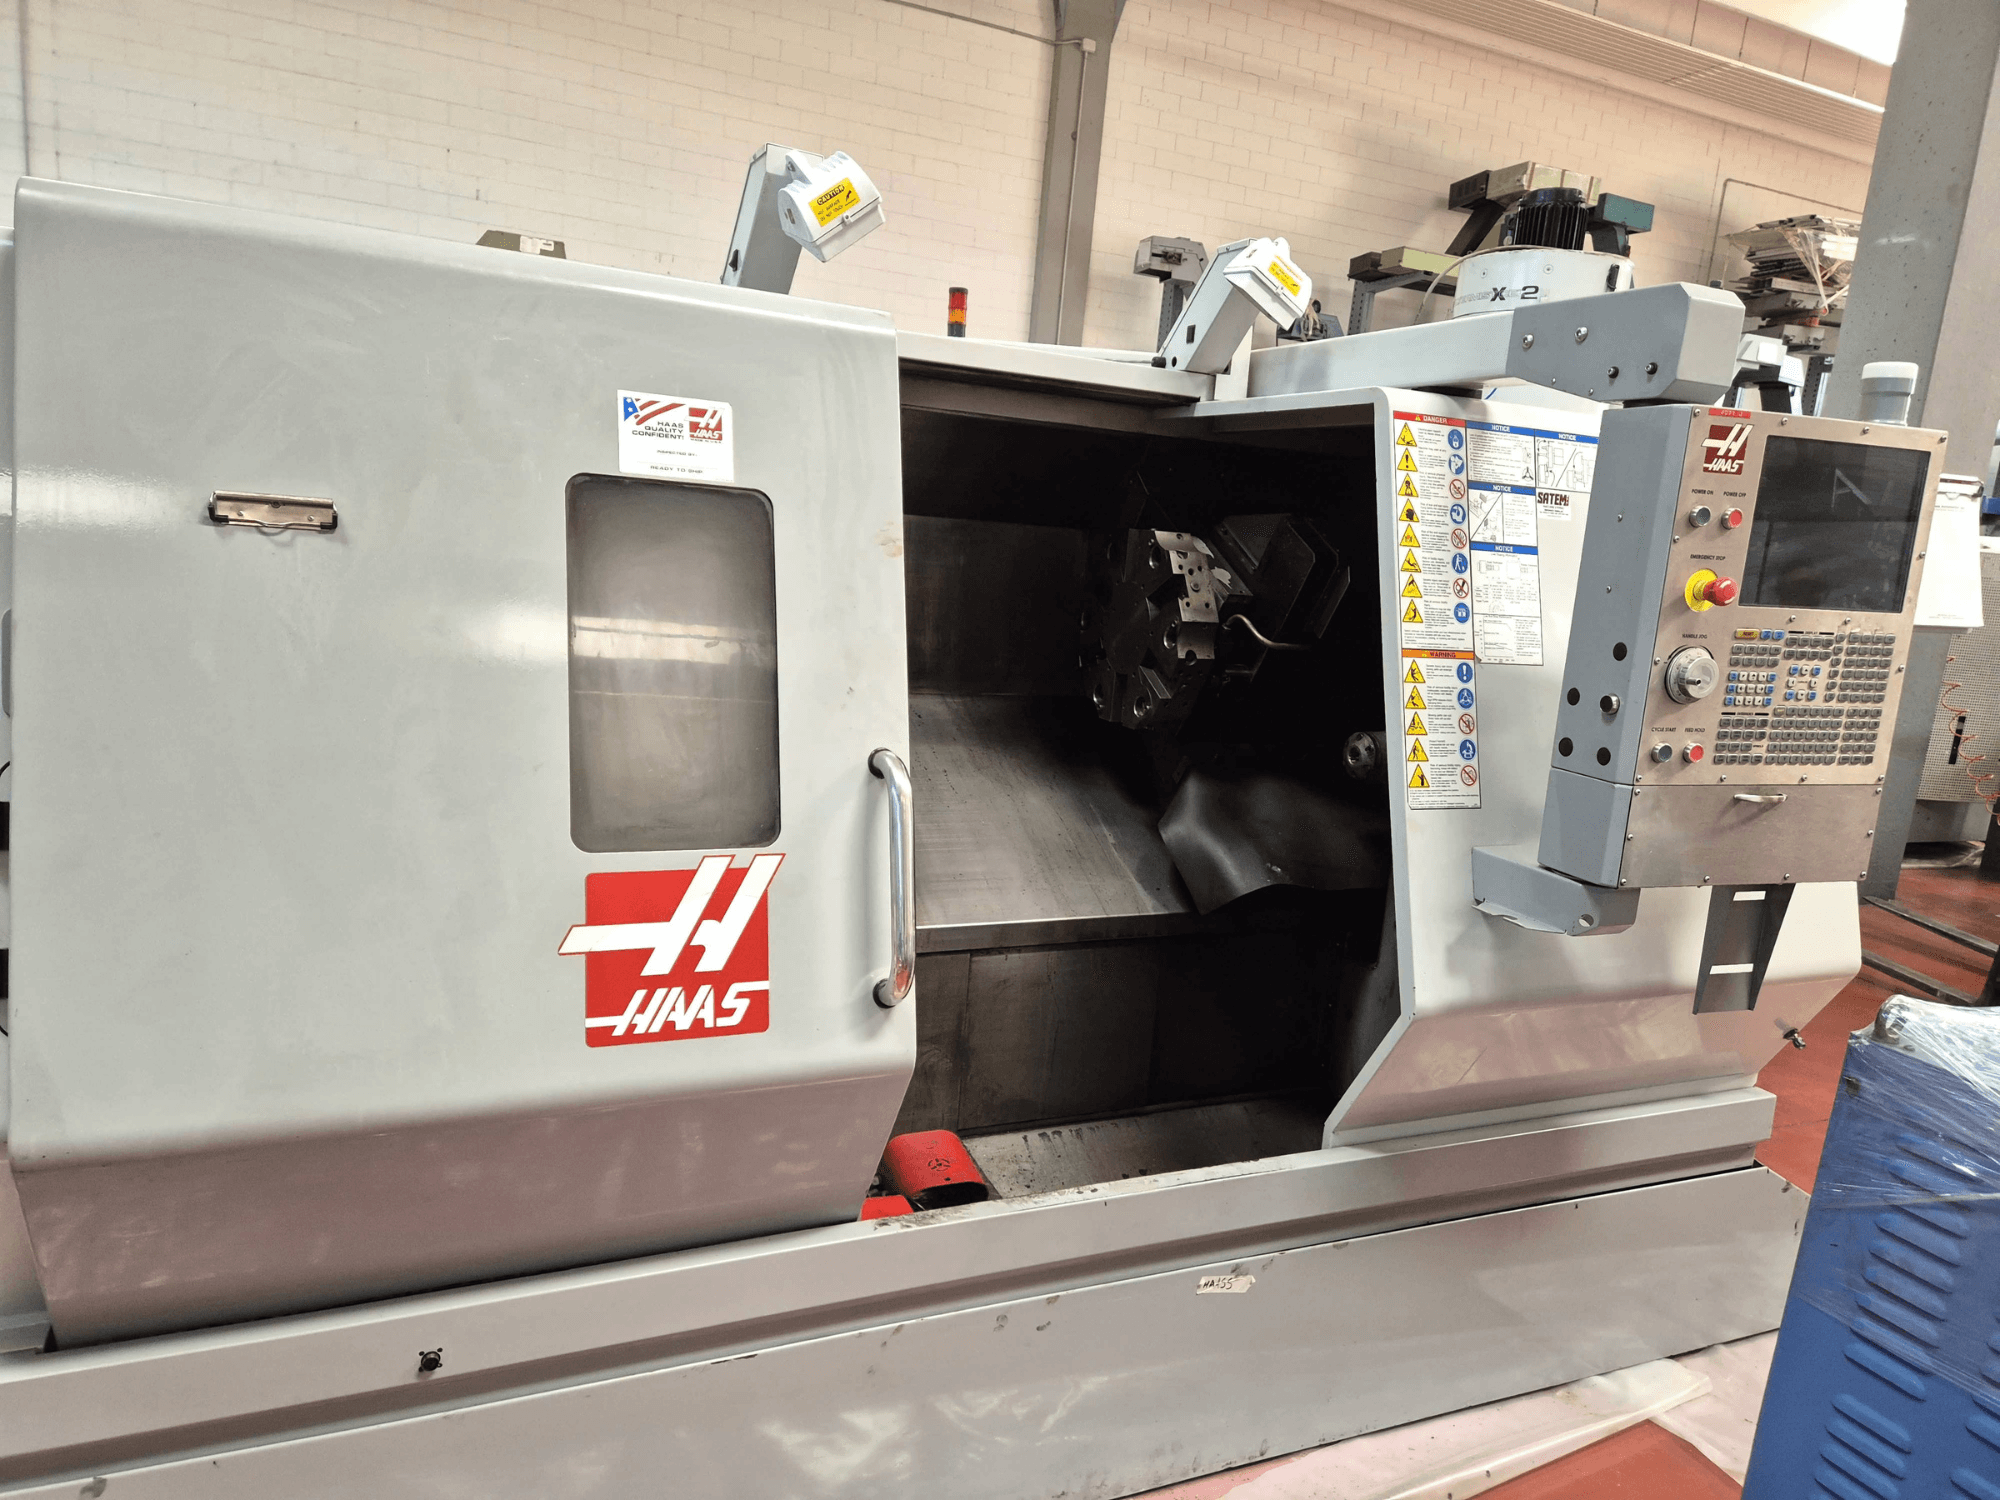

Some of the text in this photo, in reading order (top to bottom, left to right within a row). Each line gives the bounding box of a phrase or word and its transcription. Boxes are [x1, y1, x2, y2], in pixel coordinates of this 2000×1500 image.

[817, 184, 844, 205] CAUTION
[1490, 286, 1507, 301] X
[1520, 285, 1540, 300] 2
[1423, 415, 1447, 424] DANGER
[644, 425, 684, 434] QUALITY
[1491, 424, 1511, 433] NOTICE
[631, 430, 684, 440] CONFIDENT!
[689, 429, 723, 440] HAAS
[1558, 433, 1577, 441] NOTICE
[1703, 458, 1745, 473] HAAS
[1492, 484, 1512, 492] NOTICE
[1537, 491, 1567, 506] SATEM
[1494, 545, 1514, 553] NOTICE
[1429, 650, 1457, 658] WARNING
[585, 980, 770, 1037] HAAS
